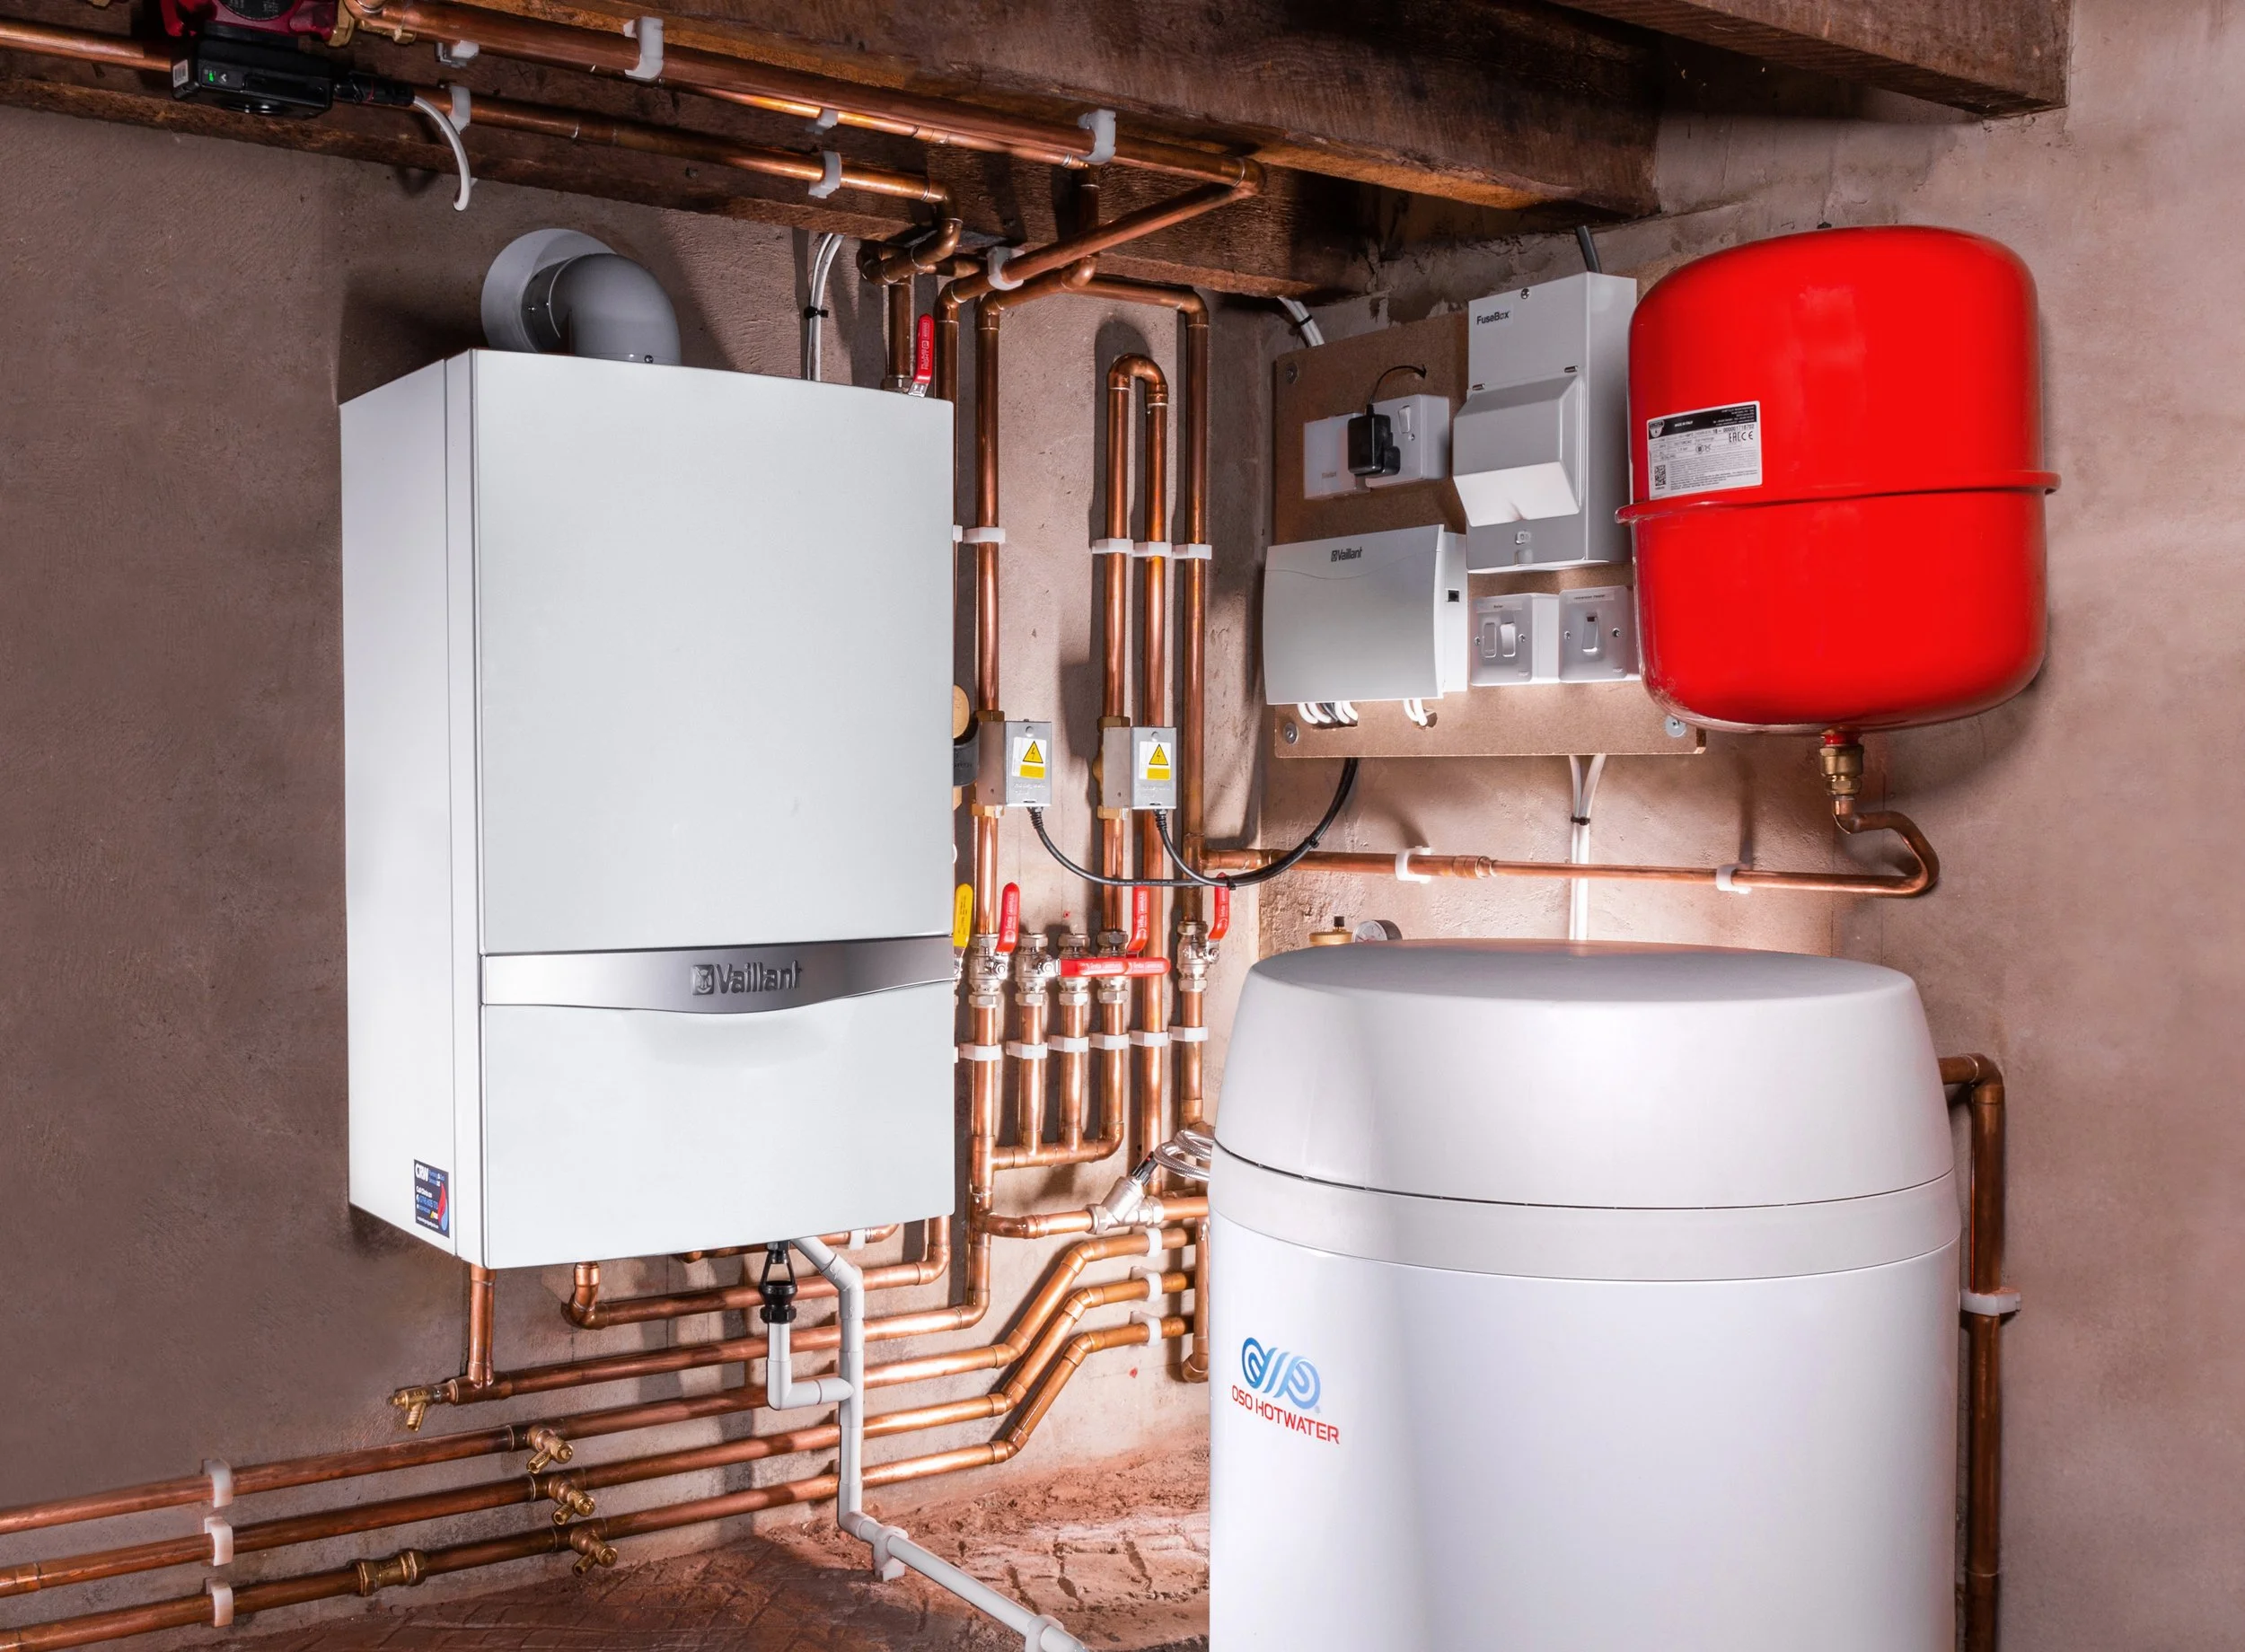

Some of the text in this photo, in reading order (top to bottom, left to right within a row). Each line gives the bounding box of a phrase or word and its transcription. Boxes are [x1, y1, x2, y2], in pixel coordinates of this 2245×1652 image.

[1476, 310, 1510, 326] FuseBox
[716, 960, 803, 994] Vaillant
[1231, 1384, 1341, 1445] OSO HOTWATER
